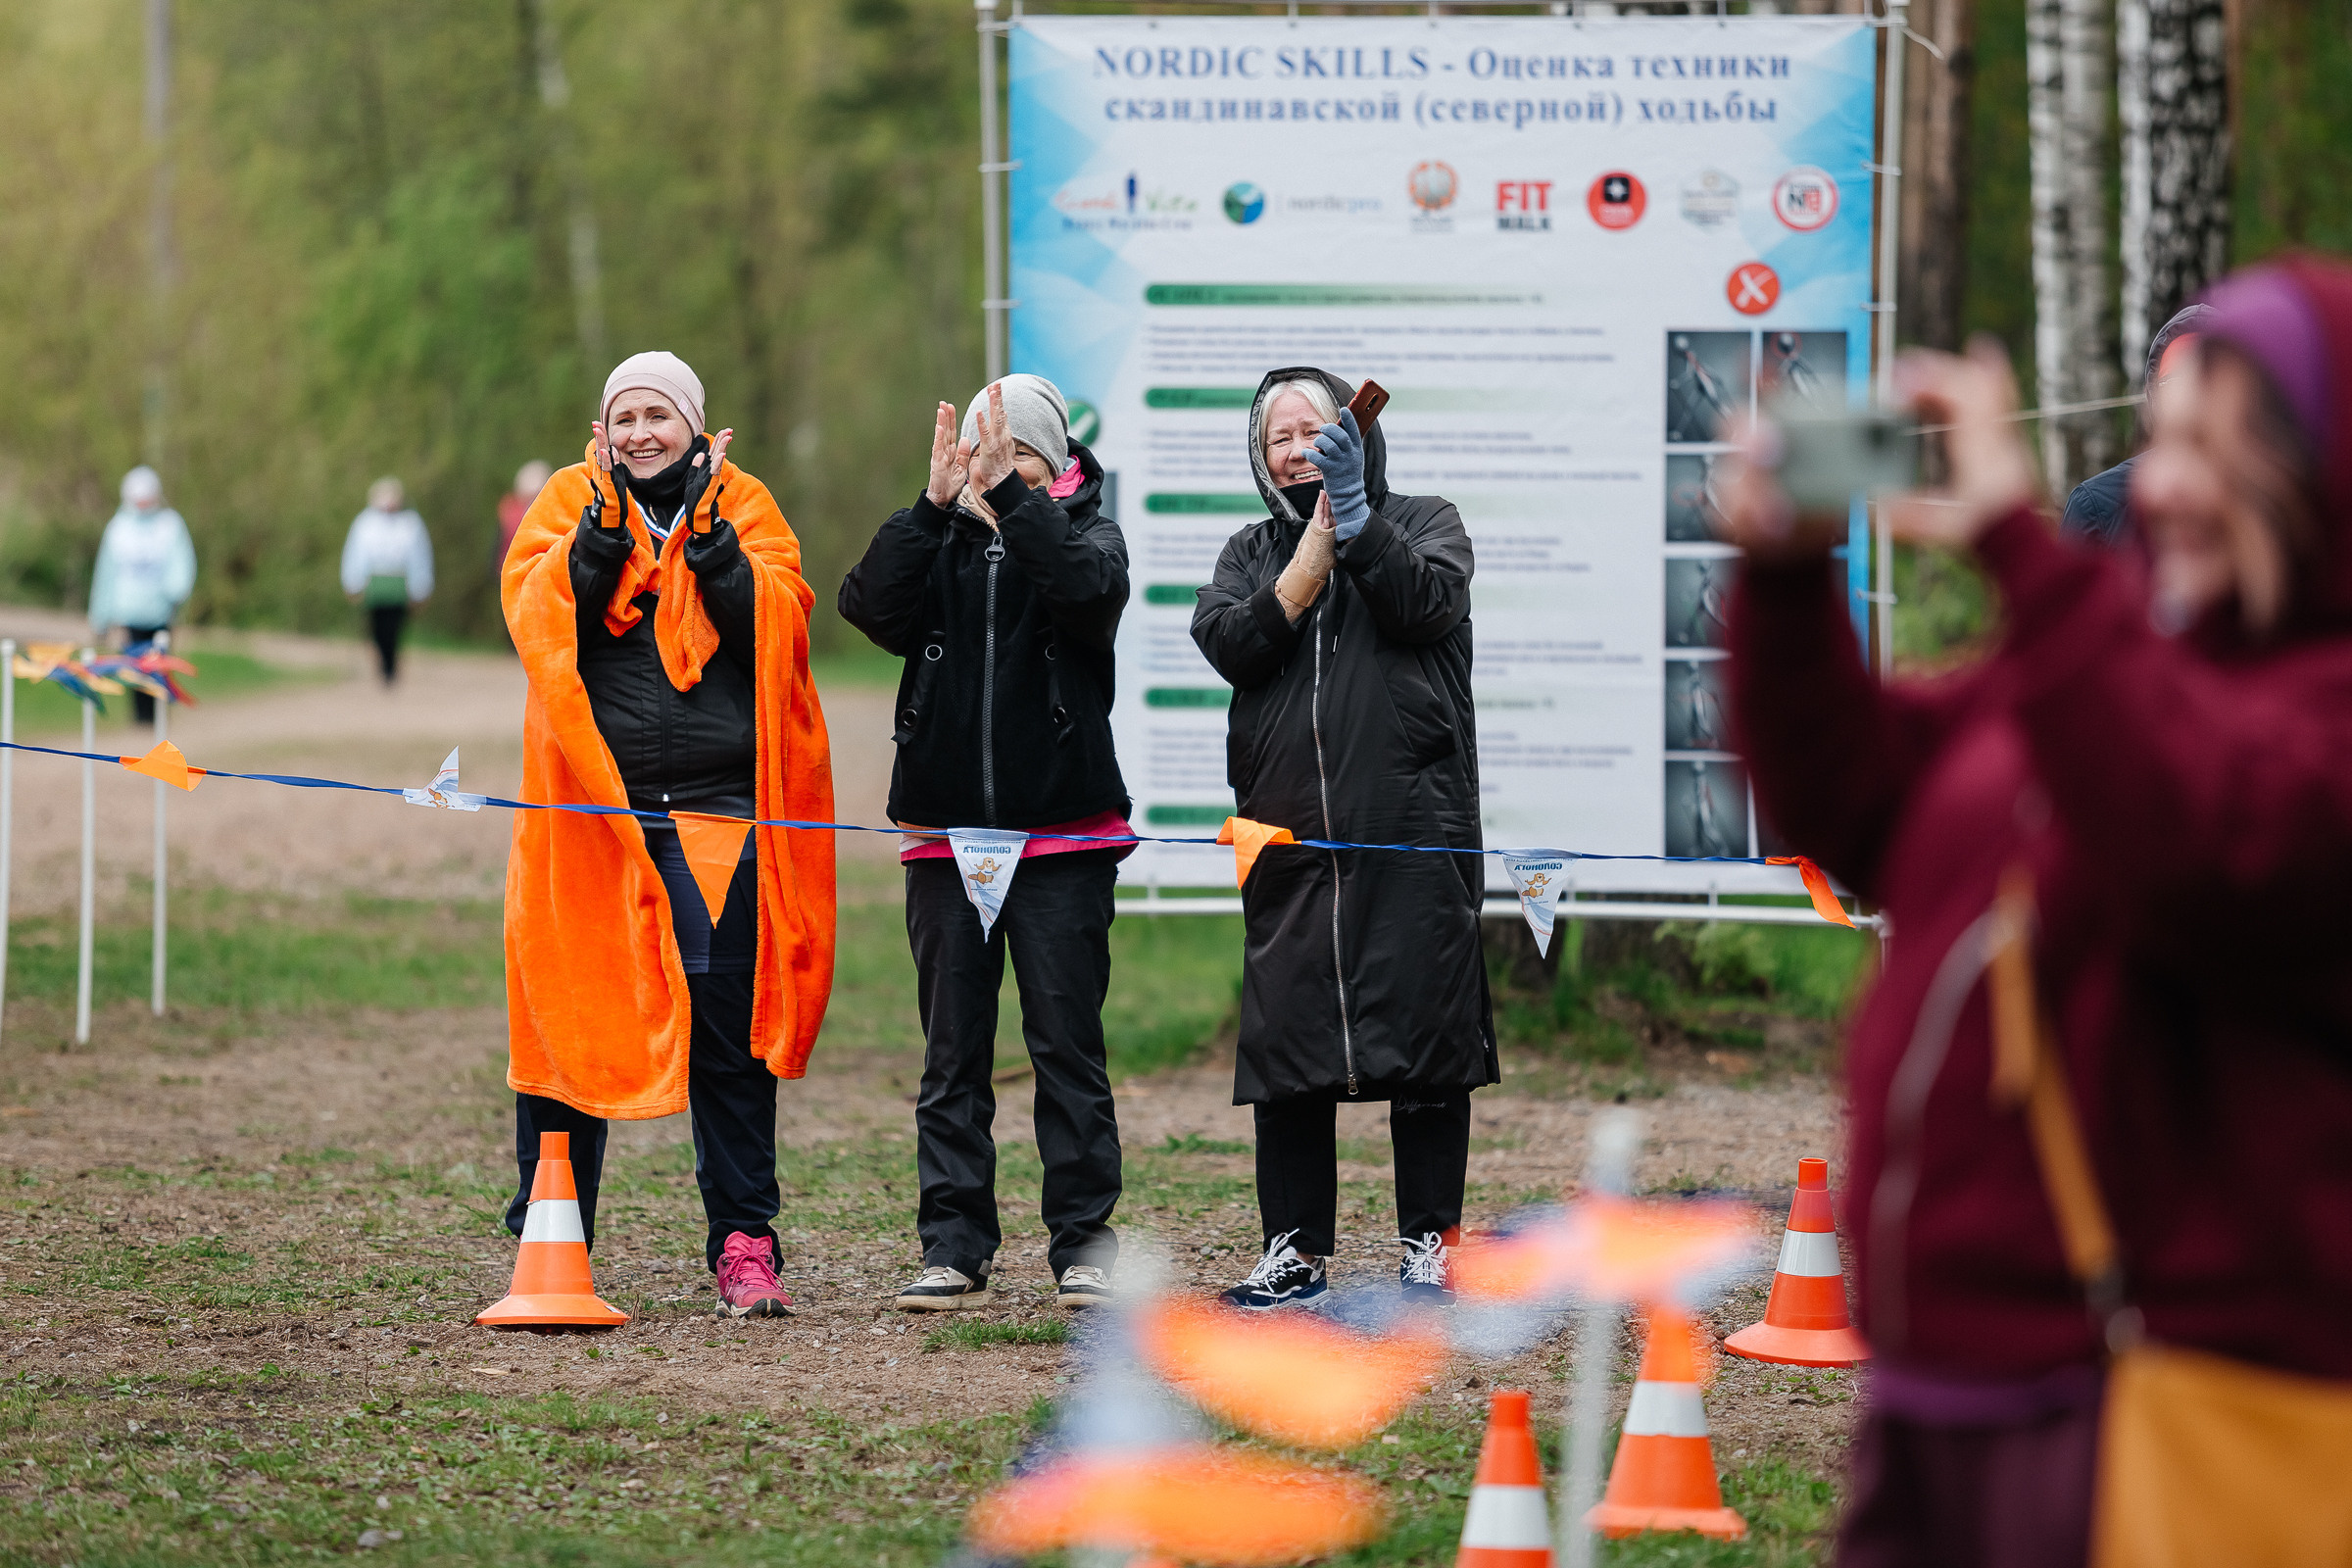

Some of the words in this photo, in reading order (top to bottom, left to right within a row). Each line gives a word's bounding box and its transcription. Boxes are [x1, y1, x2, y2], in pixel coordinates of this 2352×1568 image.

[1094, 45, 1264, 79] NORDIC
[1275, 45, 1431, 79] SKILLS
[1469, 46, 1616, 80] Оценка
[1631, 55, 1791, 79] техники
[1104, 91, 1401, 123] скандинавской
[1414, 91, 1624, 130] (северной)
[1638, 91, 1778, 123] ходьбы
[1496, 181, 1551, 211] FIT
